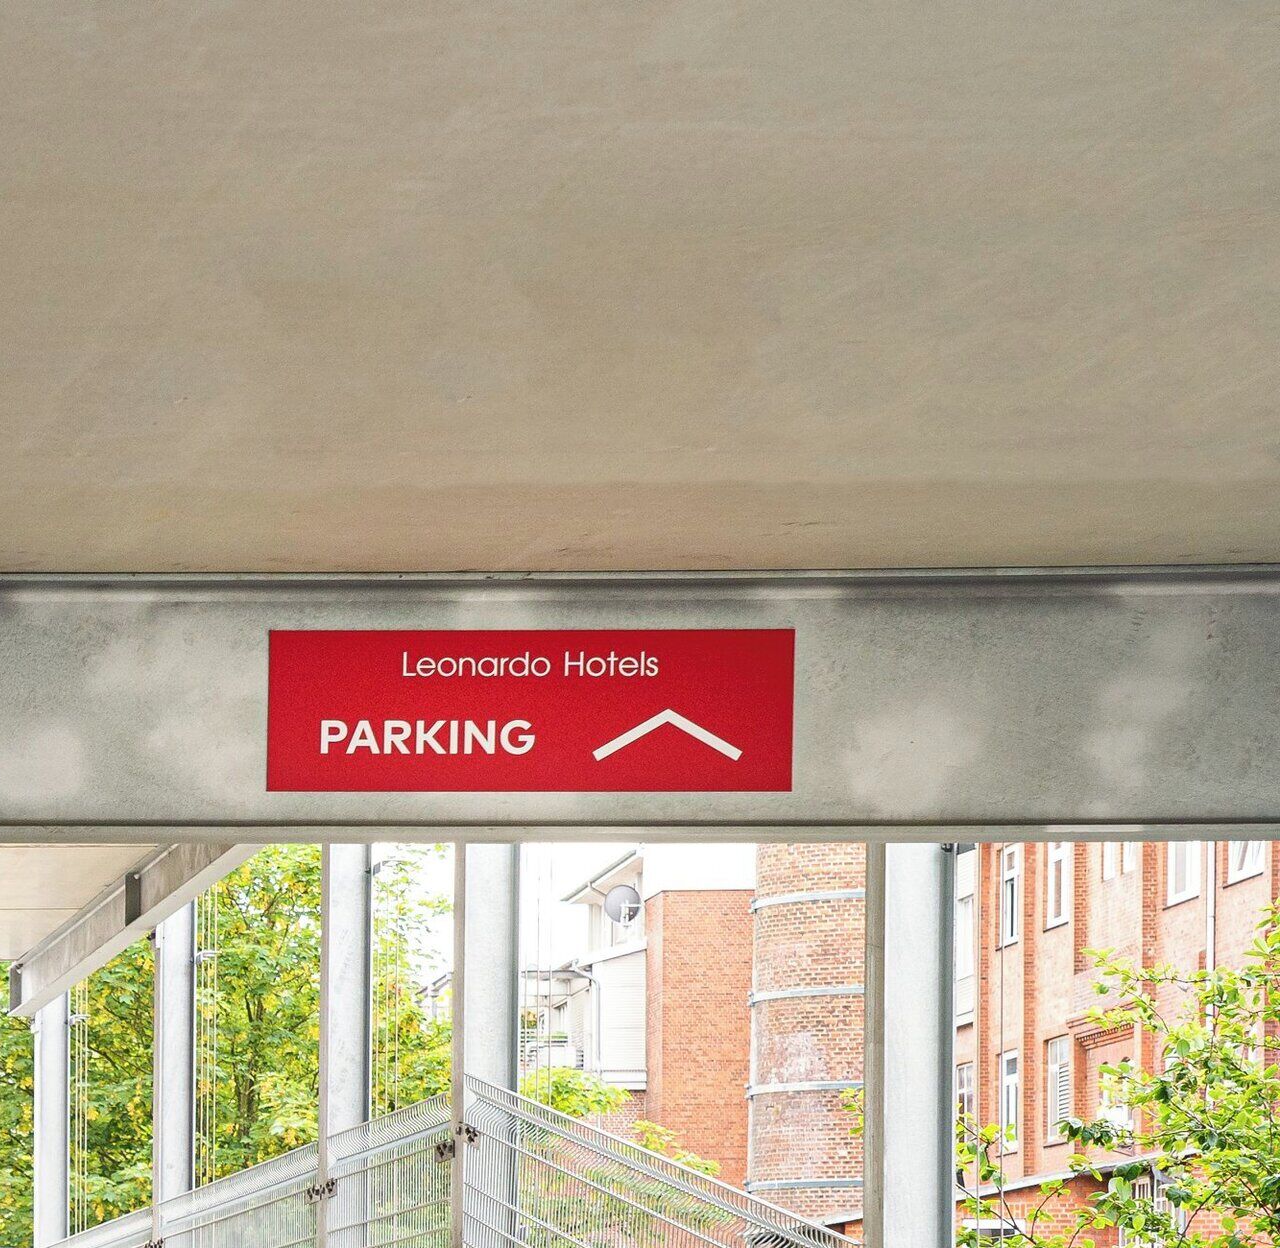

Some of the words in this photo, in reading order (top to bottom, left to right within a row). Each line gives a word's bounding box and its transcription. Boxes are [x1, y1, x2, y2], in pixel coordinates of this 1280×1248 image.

[402, 651, 551, 678] Leonardo
[564, 651, 659, 678] Hotels
[320, 719, 536, 756] PARKING
